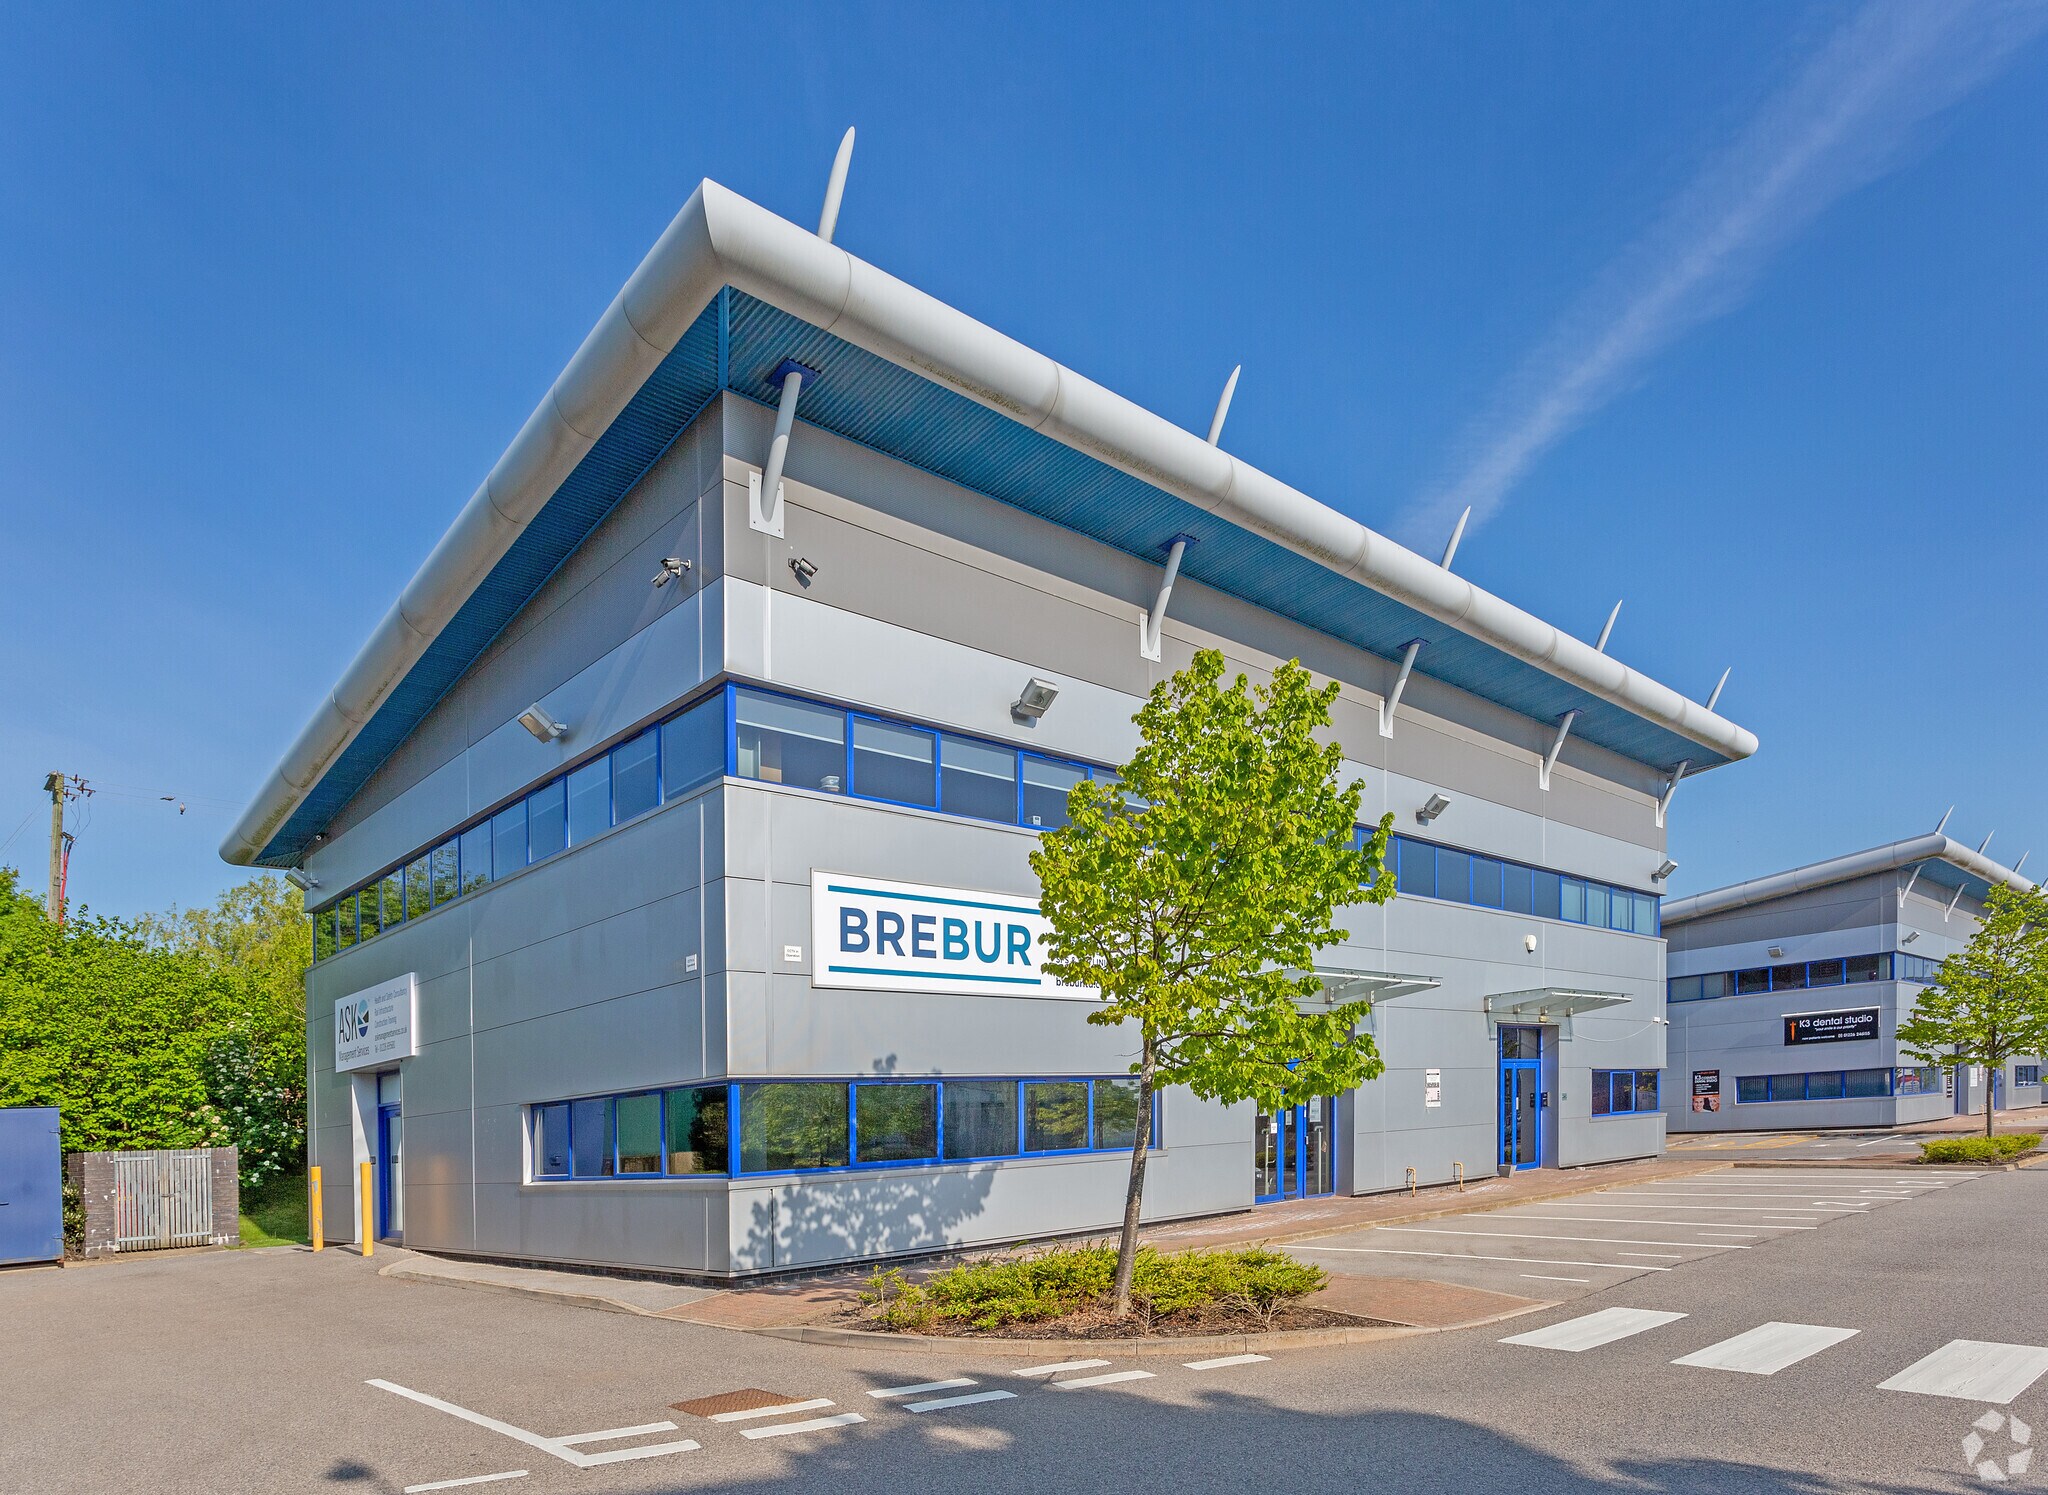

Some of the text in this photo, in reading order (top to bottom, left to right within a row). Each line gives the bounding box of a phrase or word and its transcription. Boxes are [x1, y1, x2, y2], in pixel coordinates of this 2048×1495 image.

[840, 906, 1031, 966] BREBUR
[339, 1003, 358, 1044] ASK
[1813, 1016, 1842, 1026] dental
[1844, 1014, 1872, 1024] studio
[357, 1046, 369, 1058] Services
